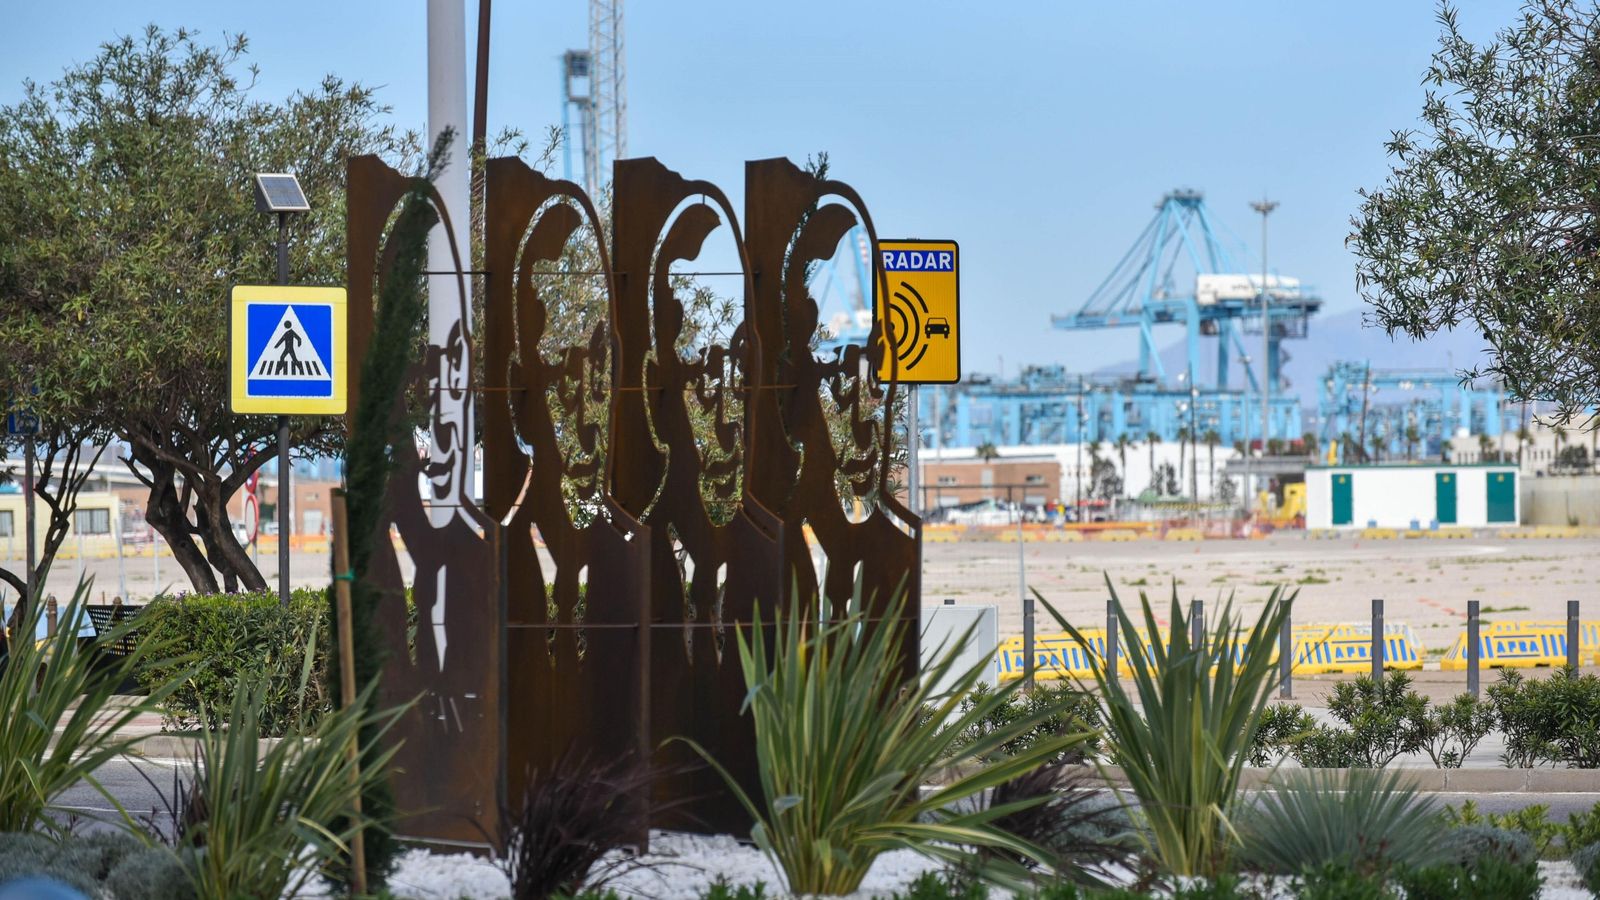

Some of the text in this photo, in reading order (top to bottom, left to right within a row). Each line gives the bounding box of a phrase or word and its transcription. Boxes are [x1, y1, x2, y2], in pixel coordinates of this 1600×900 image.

[882, 252, 951, 269] RADAR
[1335, 646, 1373, 658] APB
[1497, 641, 1540, 653] APBA
[1015, 654, 1060, 667] ABA
